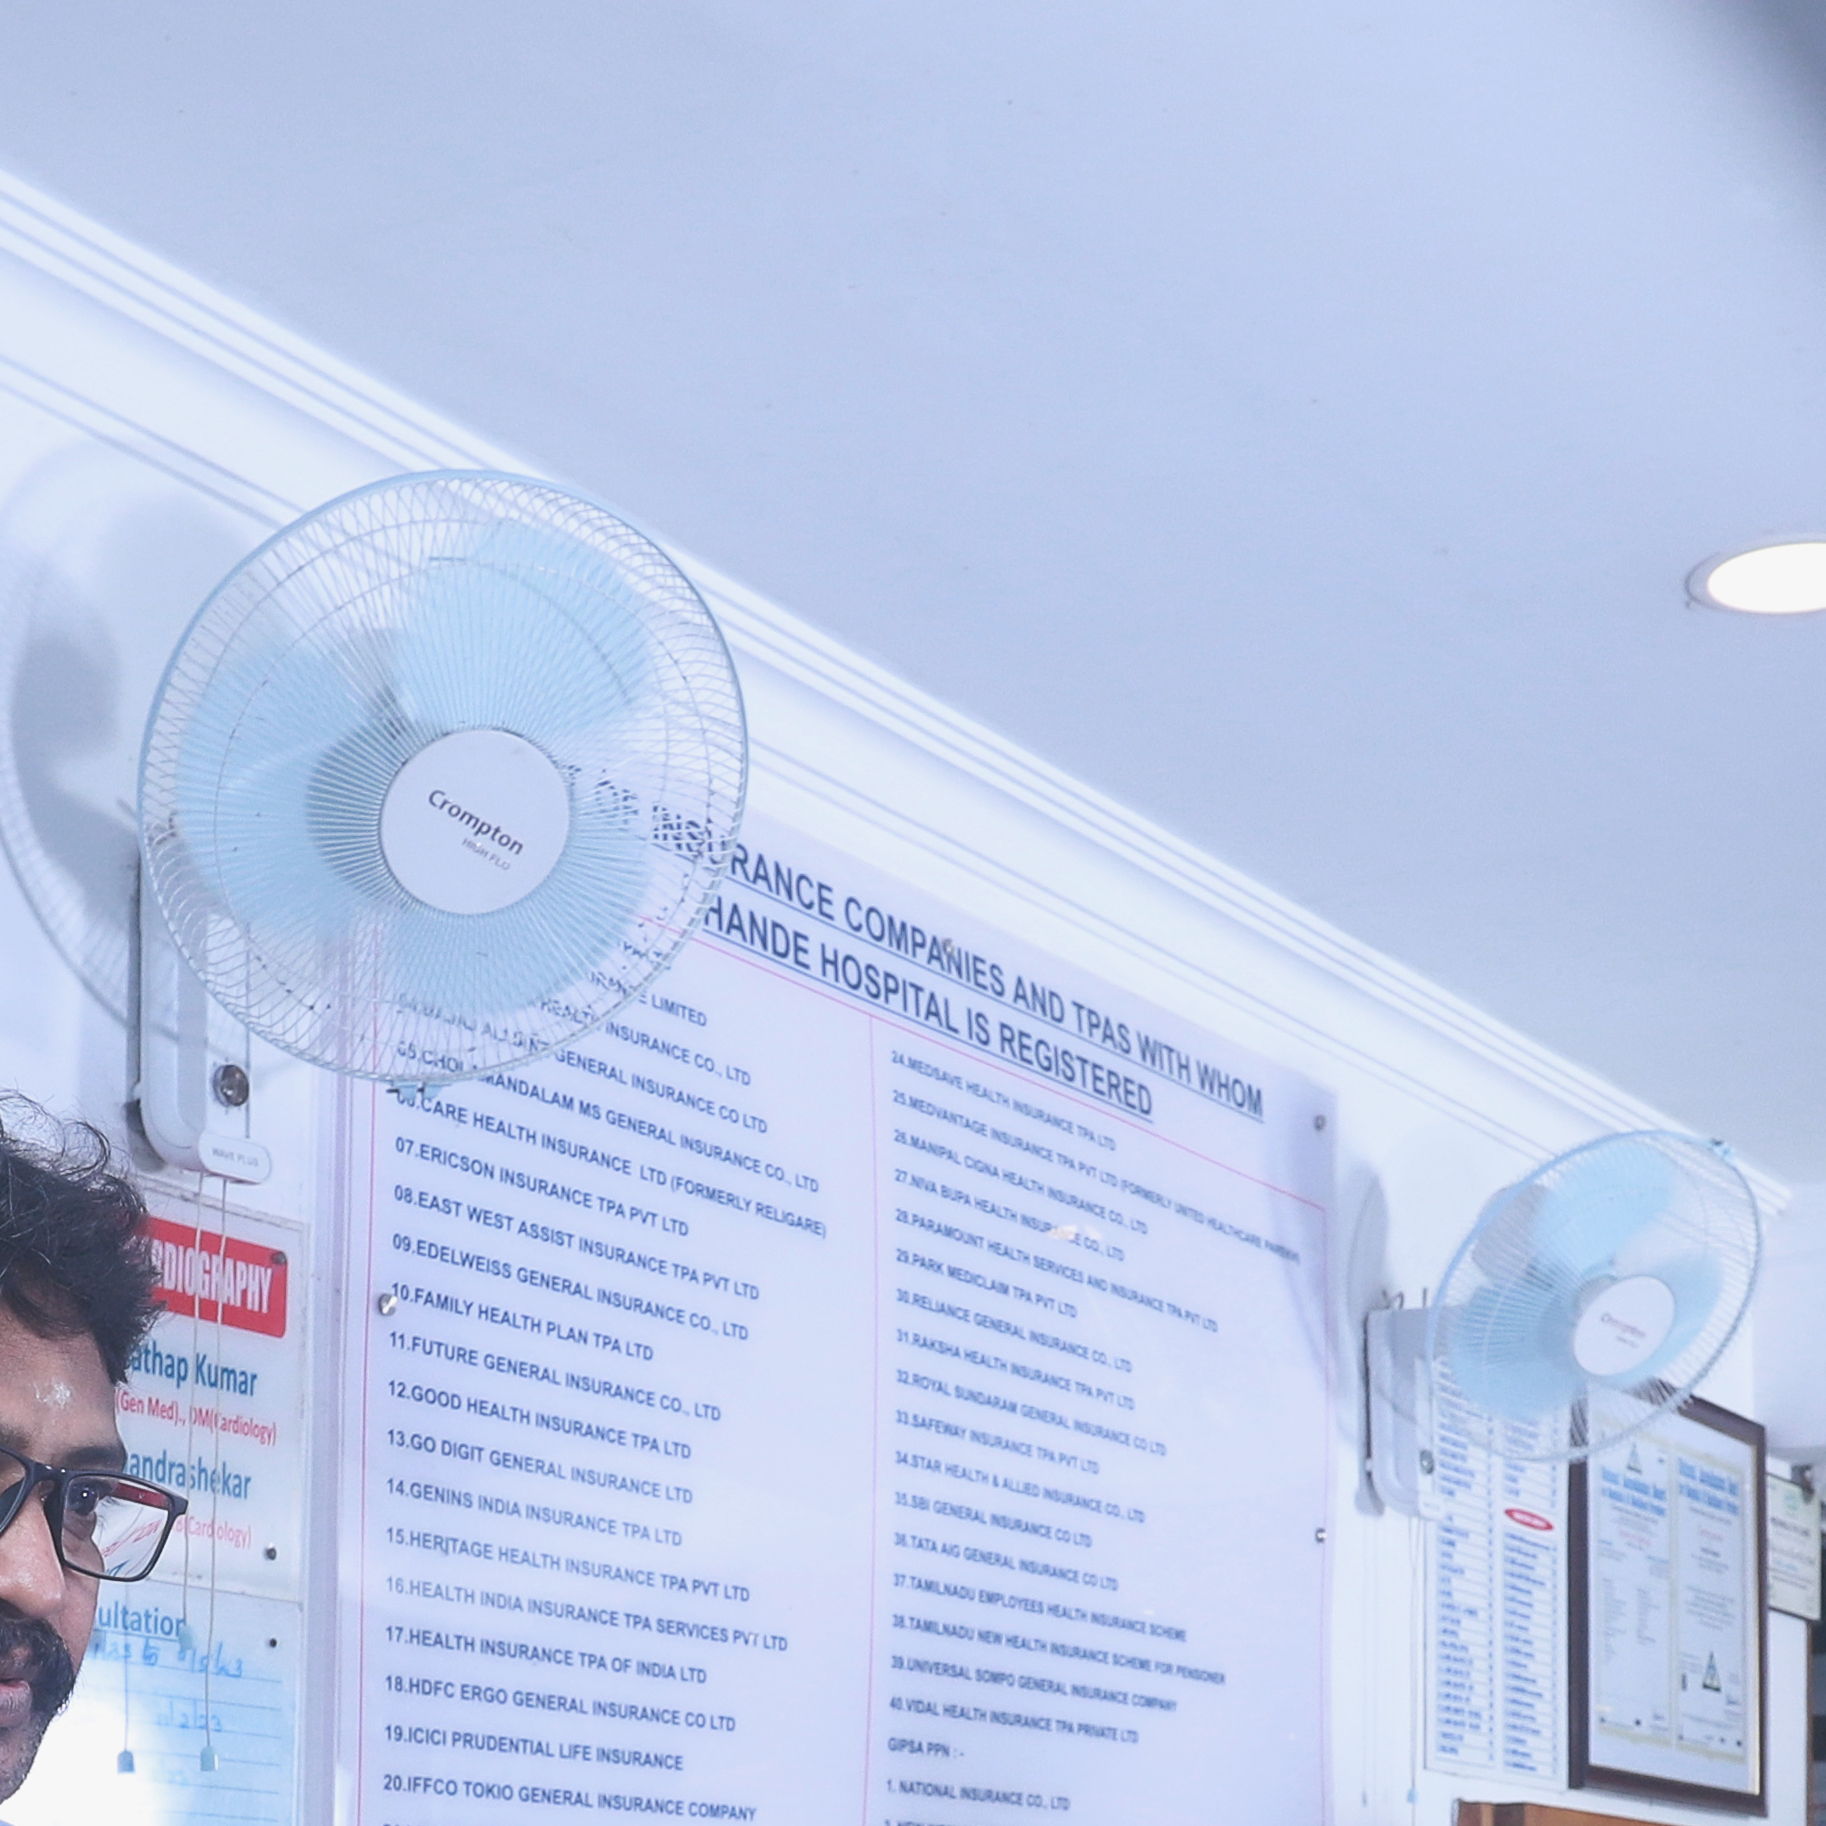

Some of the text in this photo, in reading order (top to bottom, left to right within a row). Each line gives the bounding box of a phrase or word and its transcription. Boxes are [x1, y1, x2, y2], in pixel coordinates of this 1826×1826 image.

[427, 789, 524, 856] Crompton
[705, 895, 1152, 1118] HANDE HOSPITAL IS REGISTERED
[844, 895, 1006, 999] COMPANIES
[1013, 975, 1066, 1025] AND
[1071, 1000, 1133, 1057] TPAS
[1136, 1029, 1192, 1086] WITH
[1196, 1058, 1264, 1118] WHOM
[395, 1136, 689, 1236] 07.ERICSON INSURANCE TPA PVT LTD
[388, 1282, 654, 1360] 10.FAMILY HEALTH PLAN TPA LTD
[195, 1352, 258, 1396] Kumar
[387, 1428, 693, 1503] 13.GO DIGIT GENERAL INSURANCE LTD
[385, 1675, 736, 1732] 18.HDFC ERGO GENERAL INSURANCE CO LTD
[384, 1724, 683, 1770] 19.ICICI PRUDENTIAL LIFE INSURANCE
